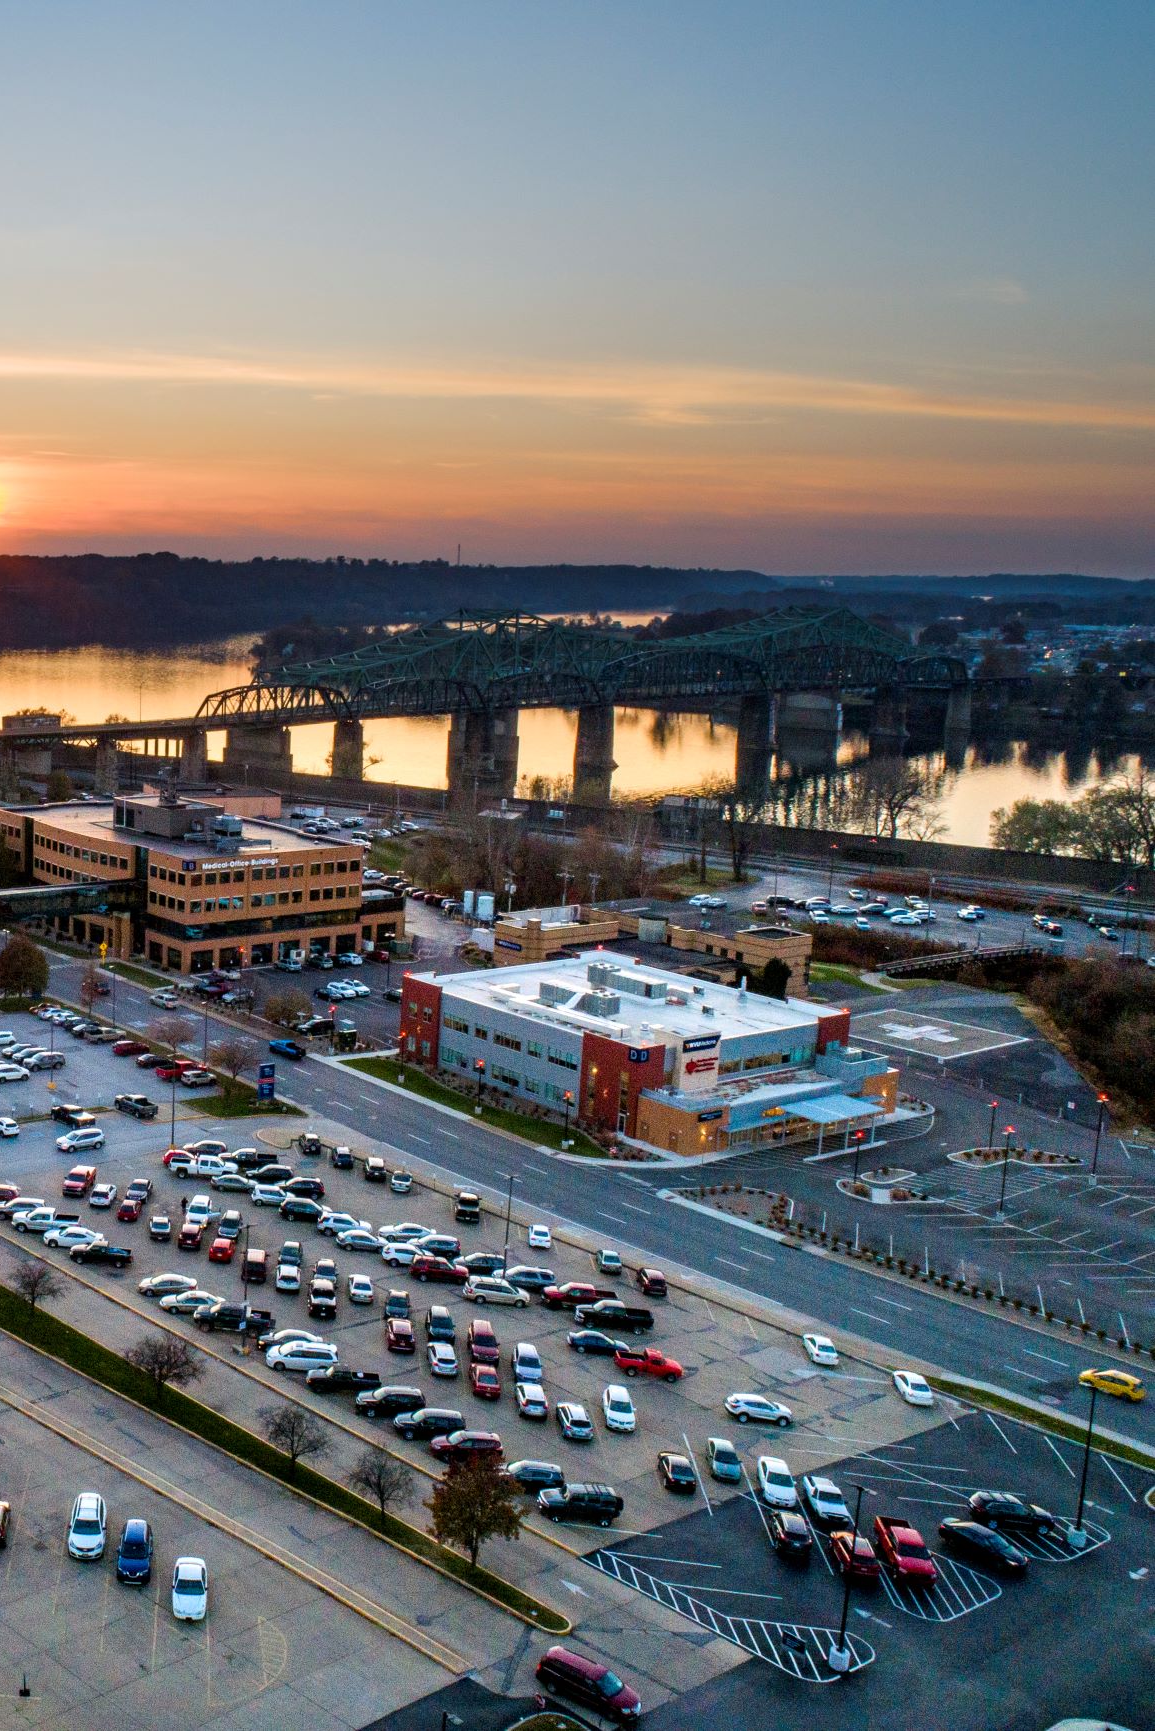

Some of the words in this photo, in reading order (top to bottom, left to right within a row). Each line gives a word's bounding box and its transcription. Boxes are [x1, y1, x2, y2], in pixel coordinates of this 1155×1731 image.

[202, 862, 228, 870] Medical
[229, 860, 249, 868] Office
[630, 1049, 637, 1060] D
[641, 1051, 648, 1061] D
